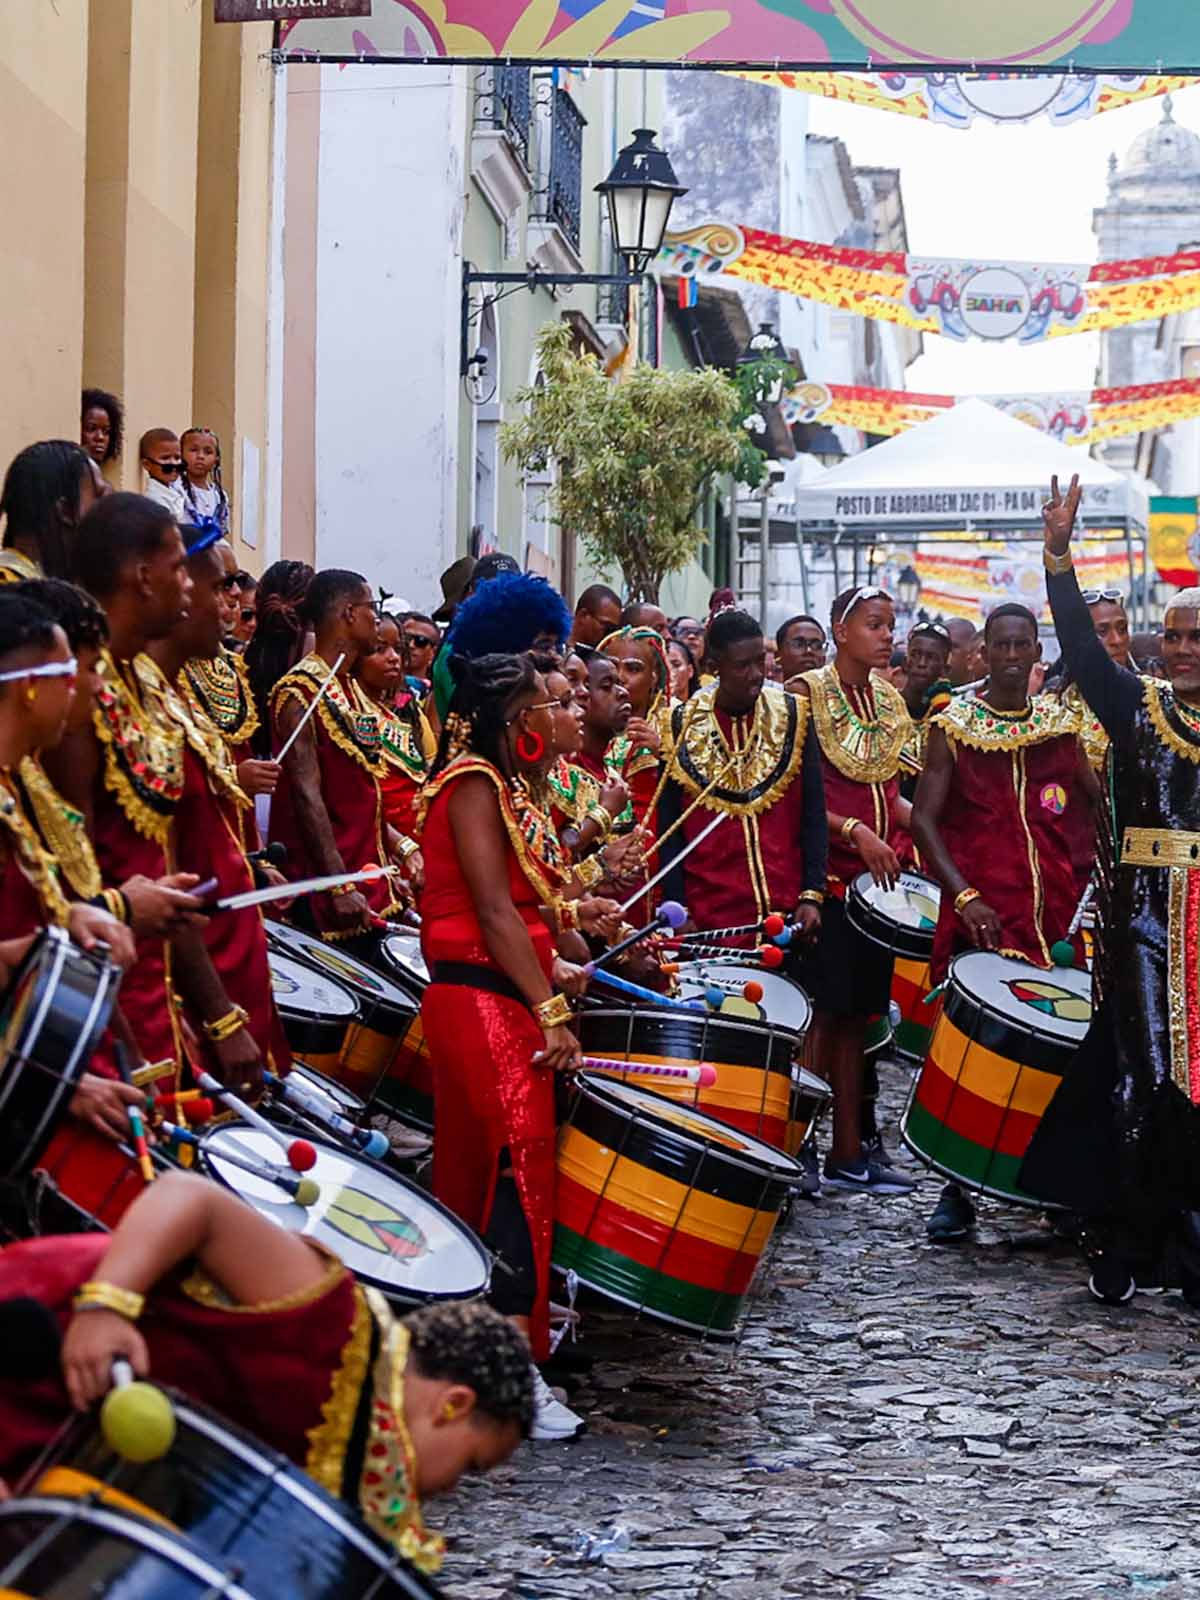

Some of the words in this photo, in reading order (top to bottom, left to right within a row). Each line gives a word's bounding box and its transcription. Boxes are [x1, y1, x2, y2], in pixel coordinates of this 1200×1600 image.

[836, 495, 872, 515] POSTO
[874, 495, 888, 515] DE
[890, 494, 957, 514] ABORDAGEM
[960, 493, 980, 512] ZAC
[1004, 491, 1019, 511] PA
